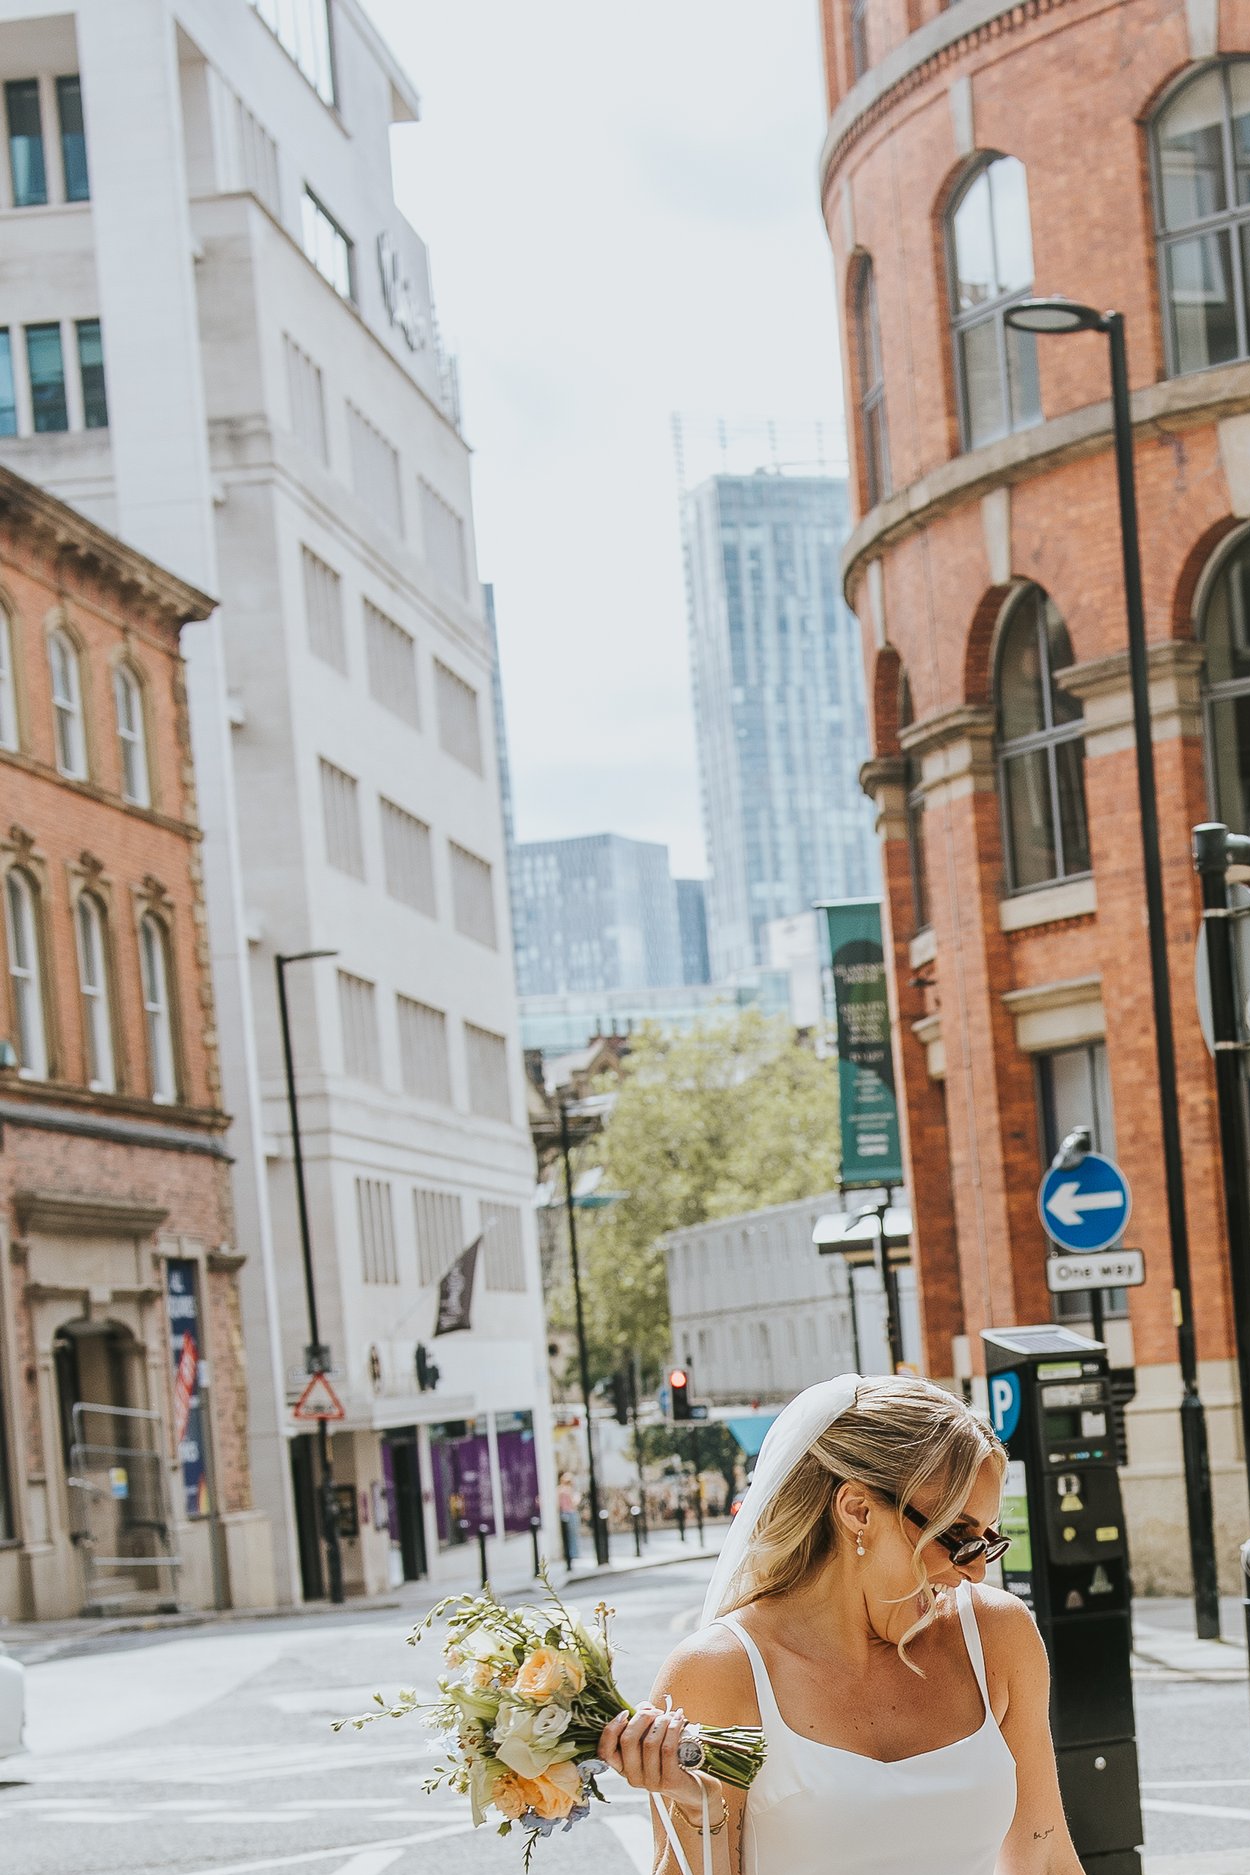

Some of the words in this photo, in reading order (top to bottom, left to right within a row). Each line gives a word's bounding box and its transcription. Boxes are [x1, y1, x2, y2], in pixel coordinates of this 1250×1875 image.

[1055, 1264, 1092, 1282] One
[1101, 1263, 1134, 1279] way
[991, 1378, 1014, 1432] P
